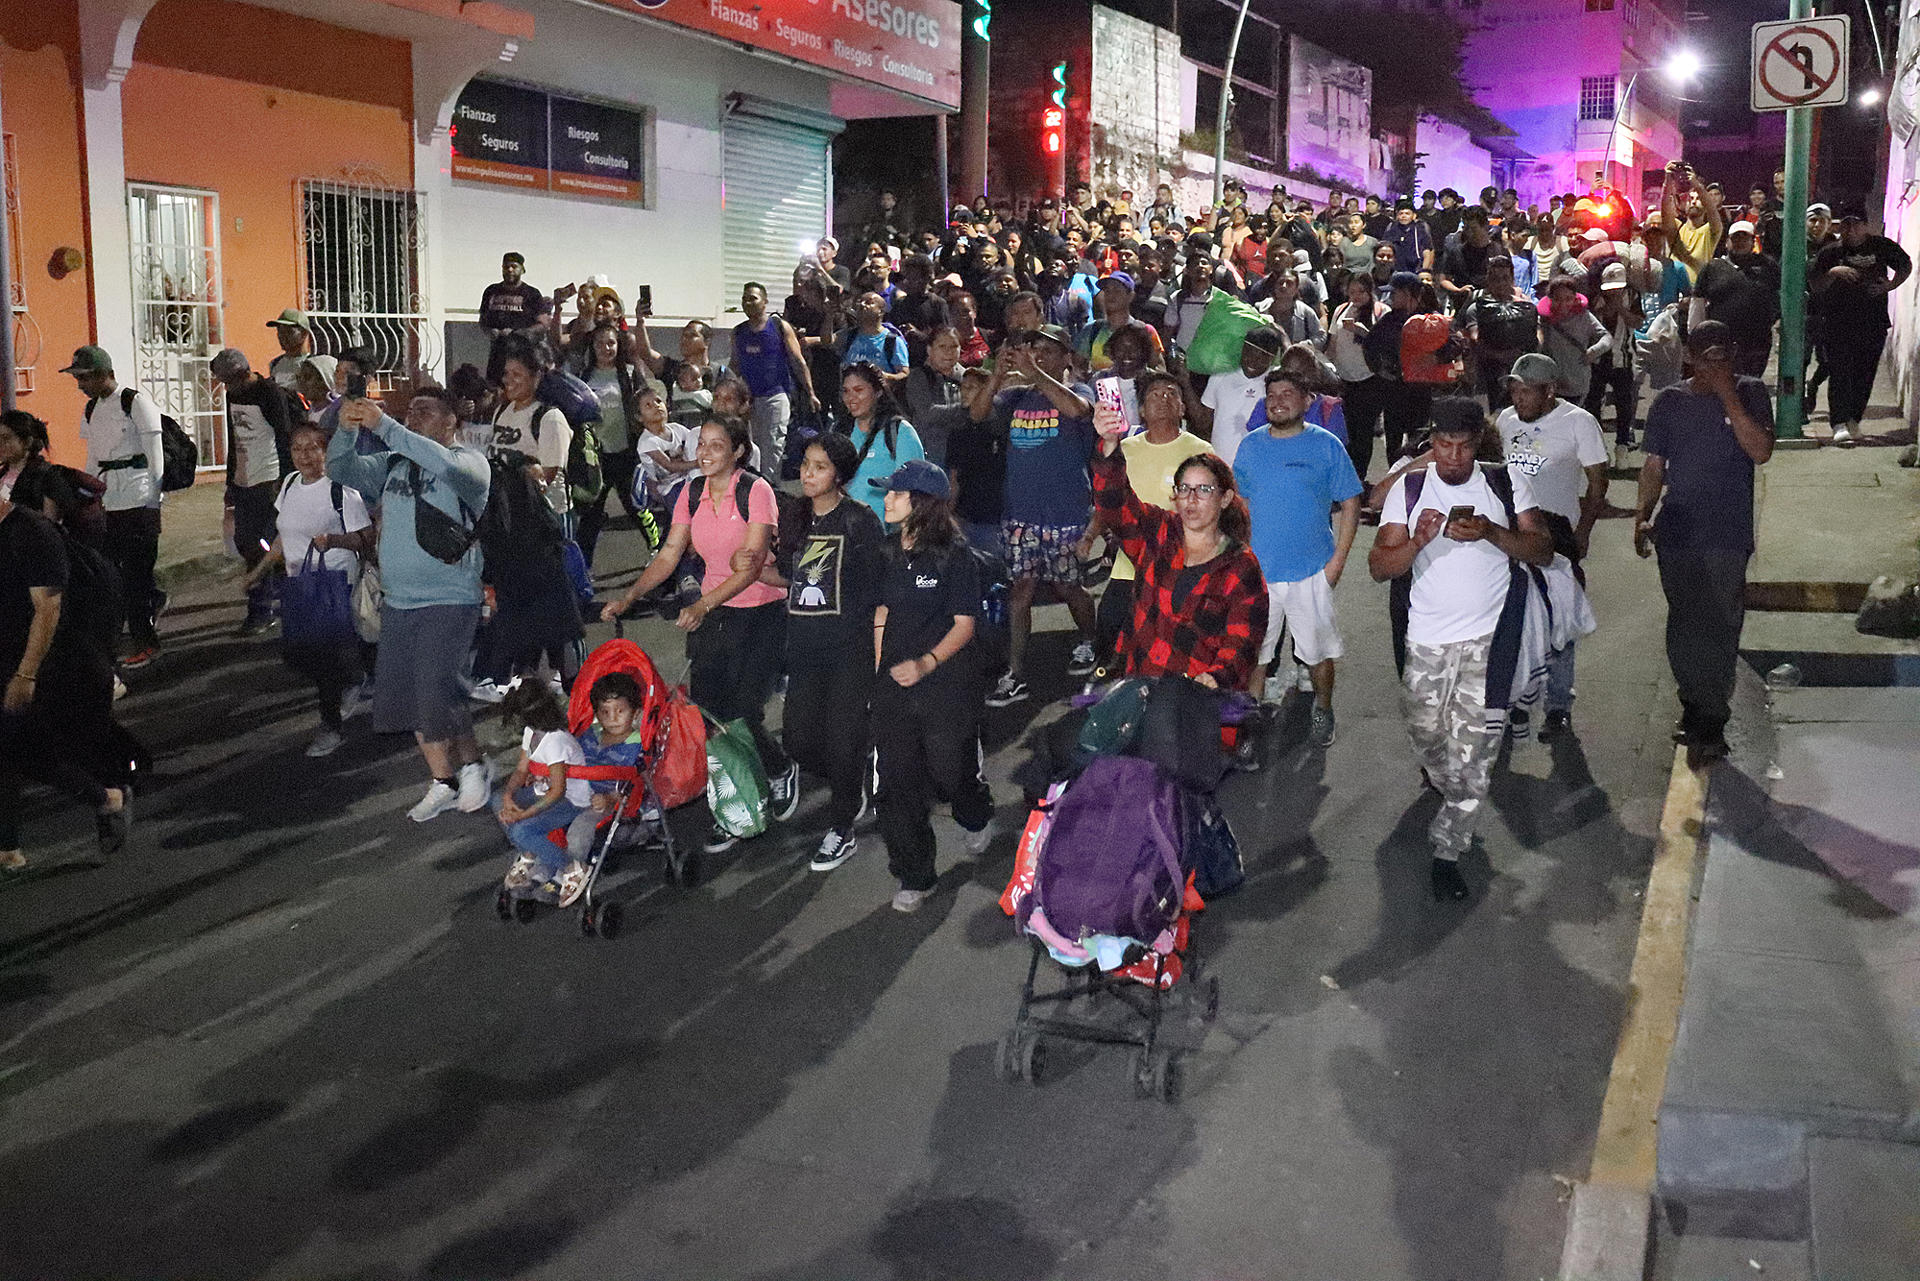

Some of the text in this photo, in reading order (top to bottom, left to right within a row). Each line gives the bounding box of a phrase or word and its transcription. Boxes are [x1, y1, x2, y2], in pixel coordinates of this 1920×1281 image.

[710, 0, 759, 31] Fianzas
[776, 18, 822, 50] Seguros
[833, 38, 873, 67] Riesgos
[461, 105, 497, 123] Fianzas
[481, 133, 519, 151] Seguros
[568, 126, 599, 143] Riesgos
